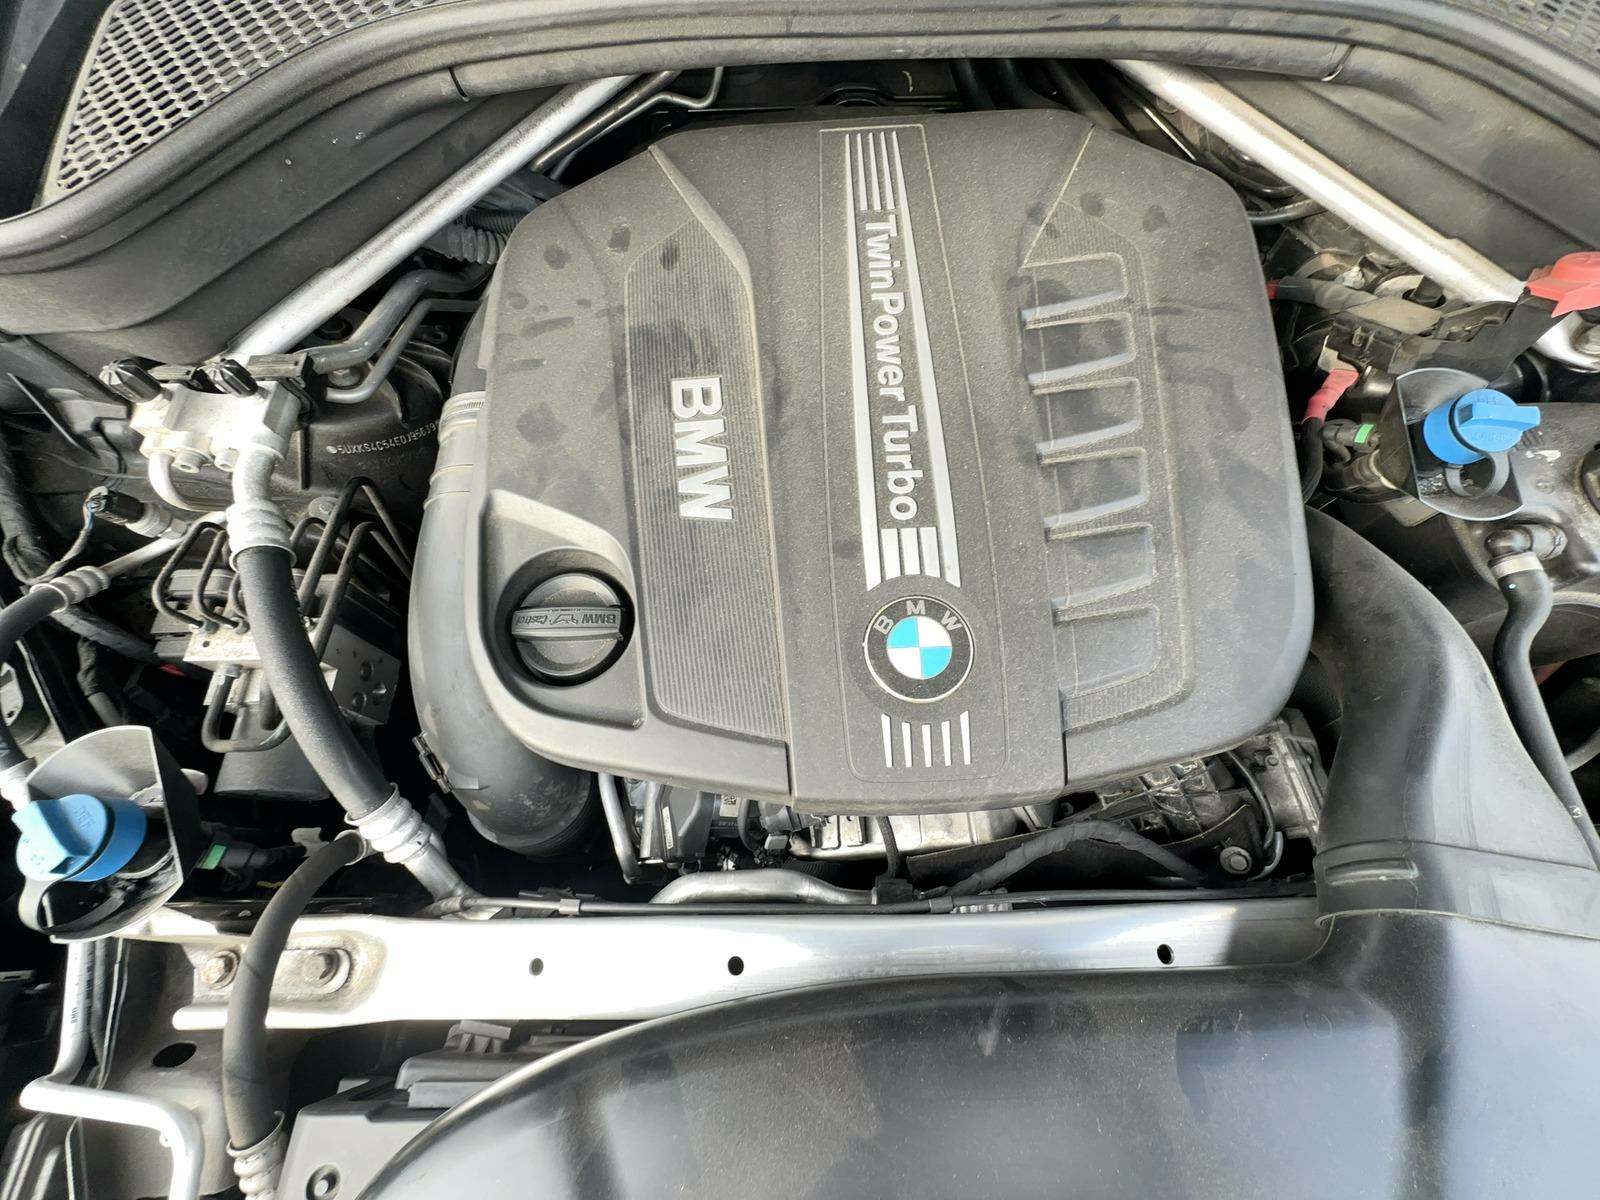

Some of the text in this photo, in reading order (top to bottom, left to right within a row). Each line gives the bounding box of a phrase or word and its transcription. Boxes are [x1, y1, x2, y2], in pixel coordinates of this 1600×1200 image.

[866, 215, 923, 520] TwinPower Turbo
[671, 377, 733, 520] BMW
[515, 613, 616, 626] BMW Castrol
[873, 600, 963, 635] BMW
